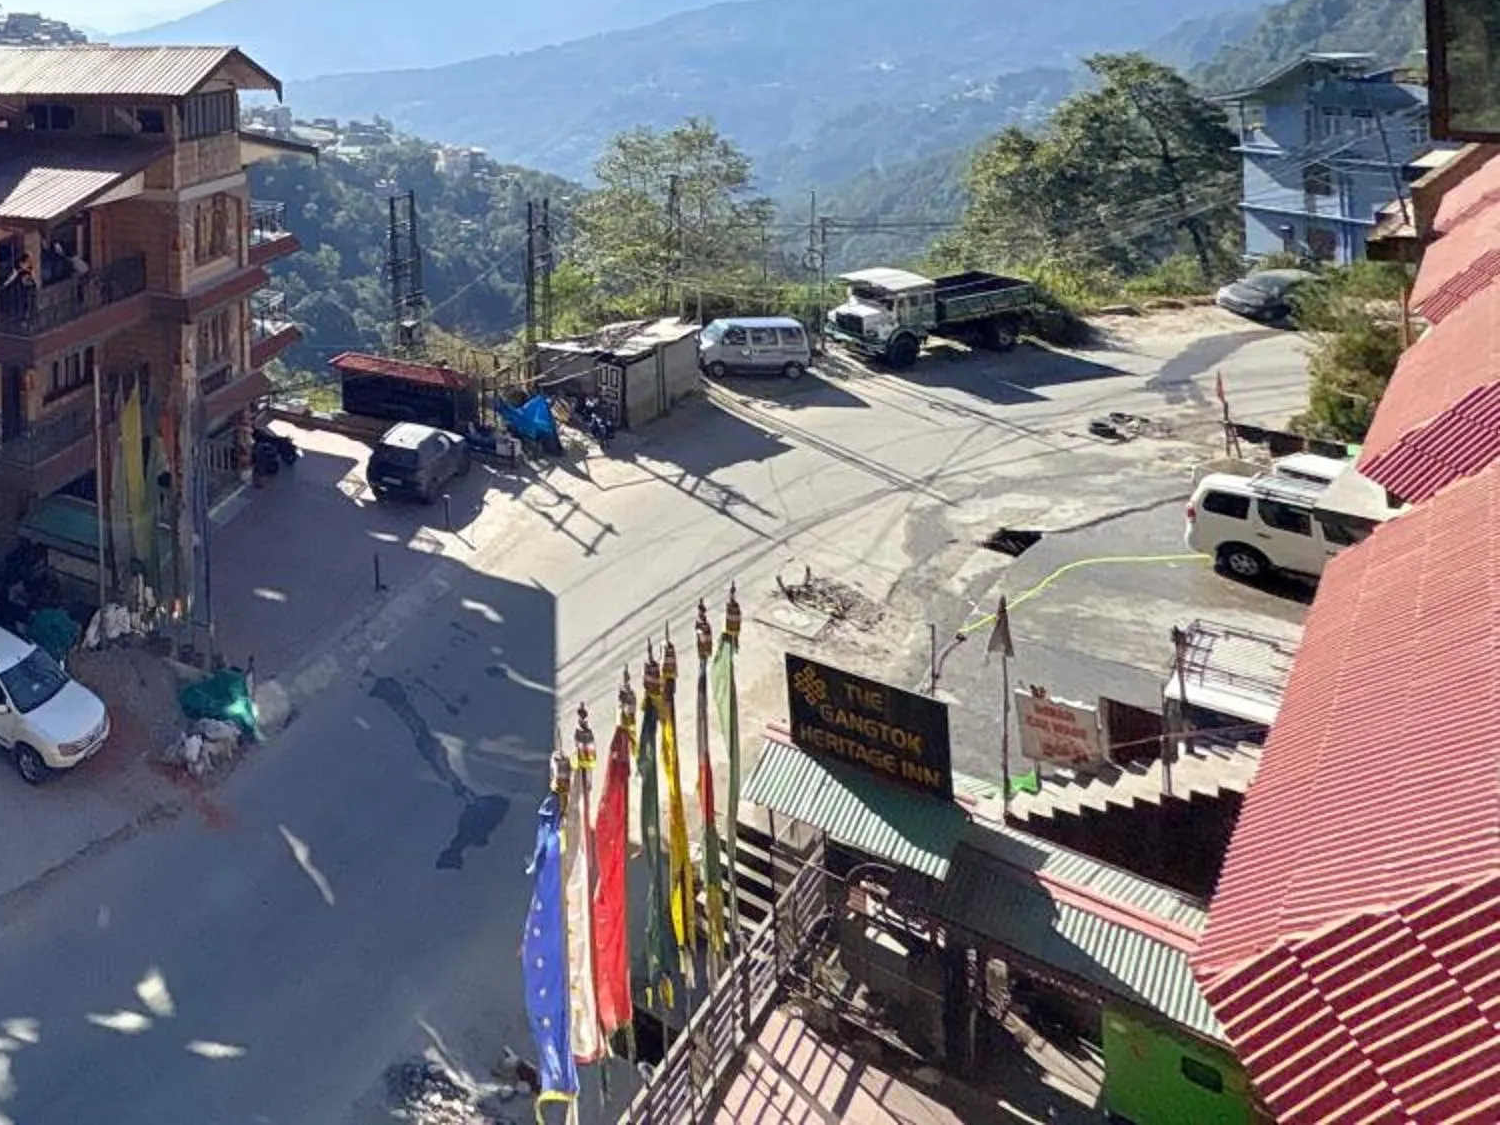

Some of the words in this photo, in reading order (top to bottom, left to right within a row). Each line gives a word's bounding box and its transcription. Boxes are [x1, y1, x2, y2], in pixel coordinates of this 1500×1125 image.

[843, 682, 883, 711] THE
[820, 704, 923, 755] GANGTOK
[801, 725, 897, 773] HERITAGE
[902, 760, 940, 787] INN
